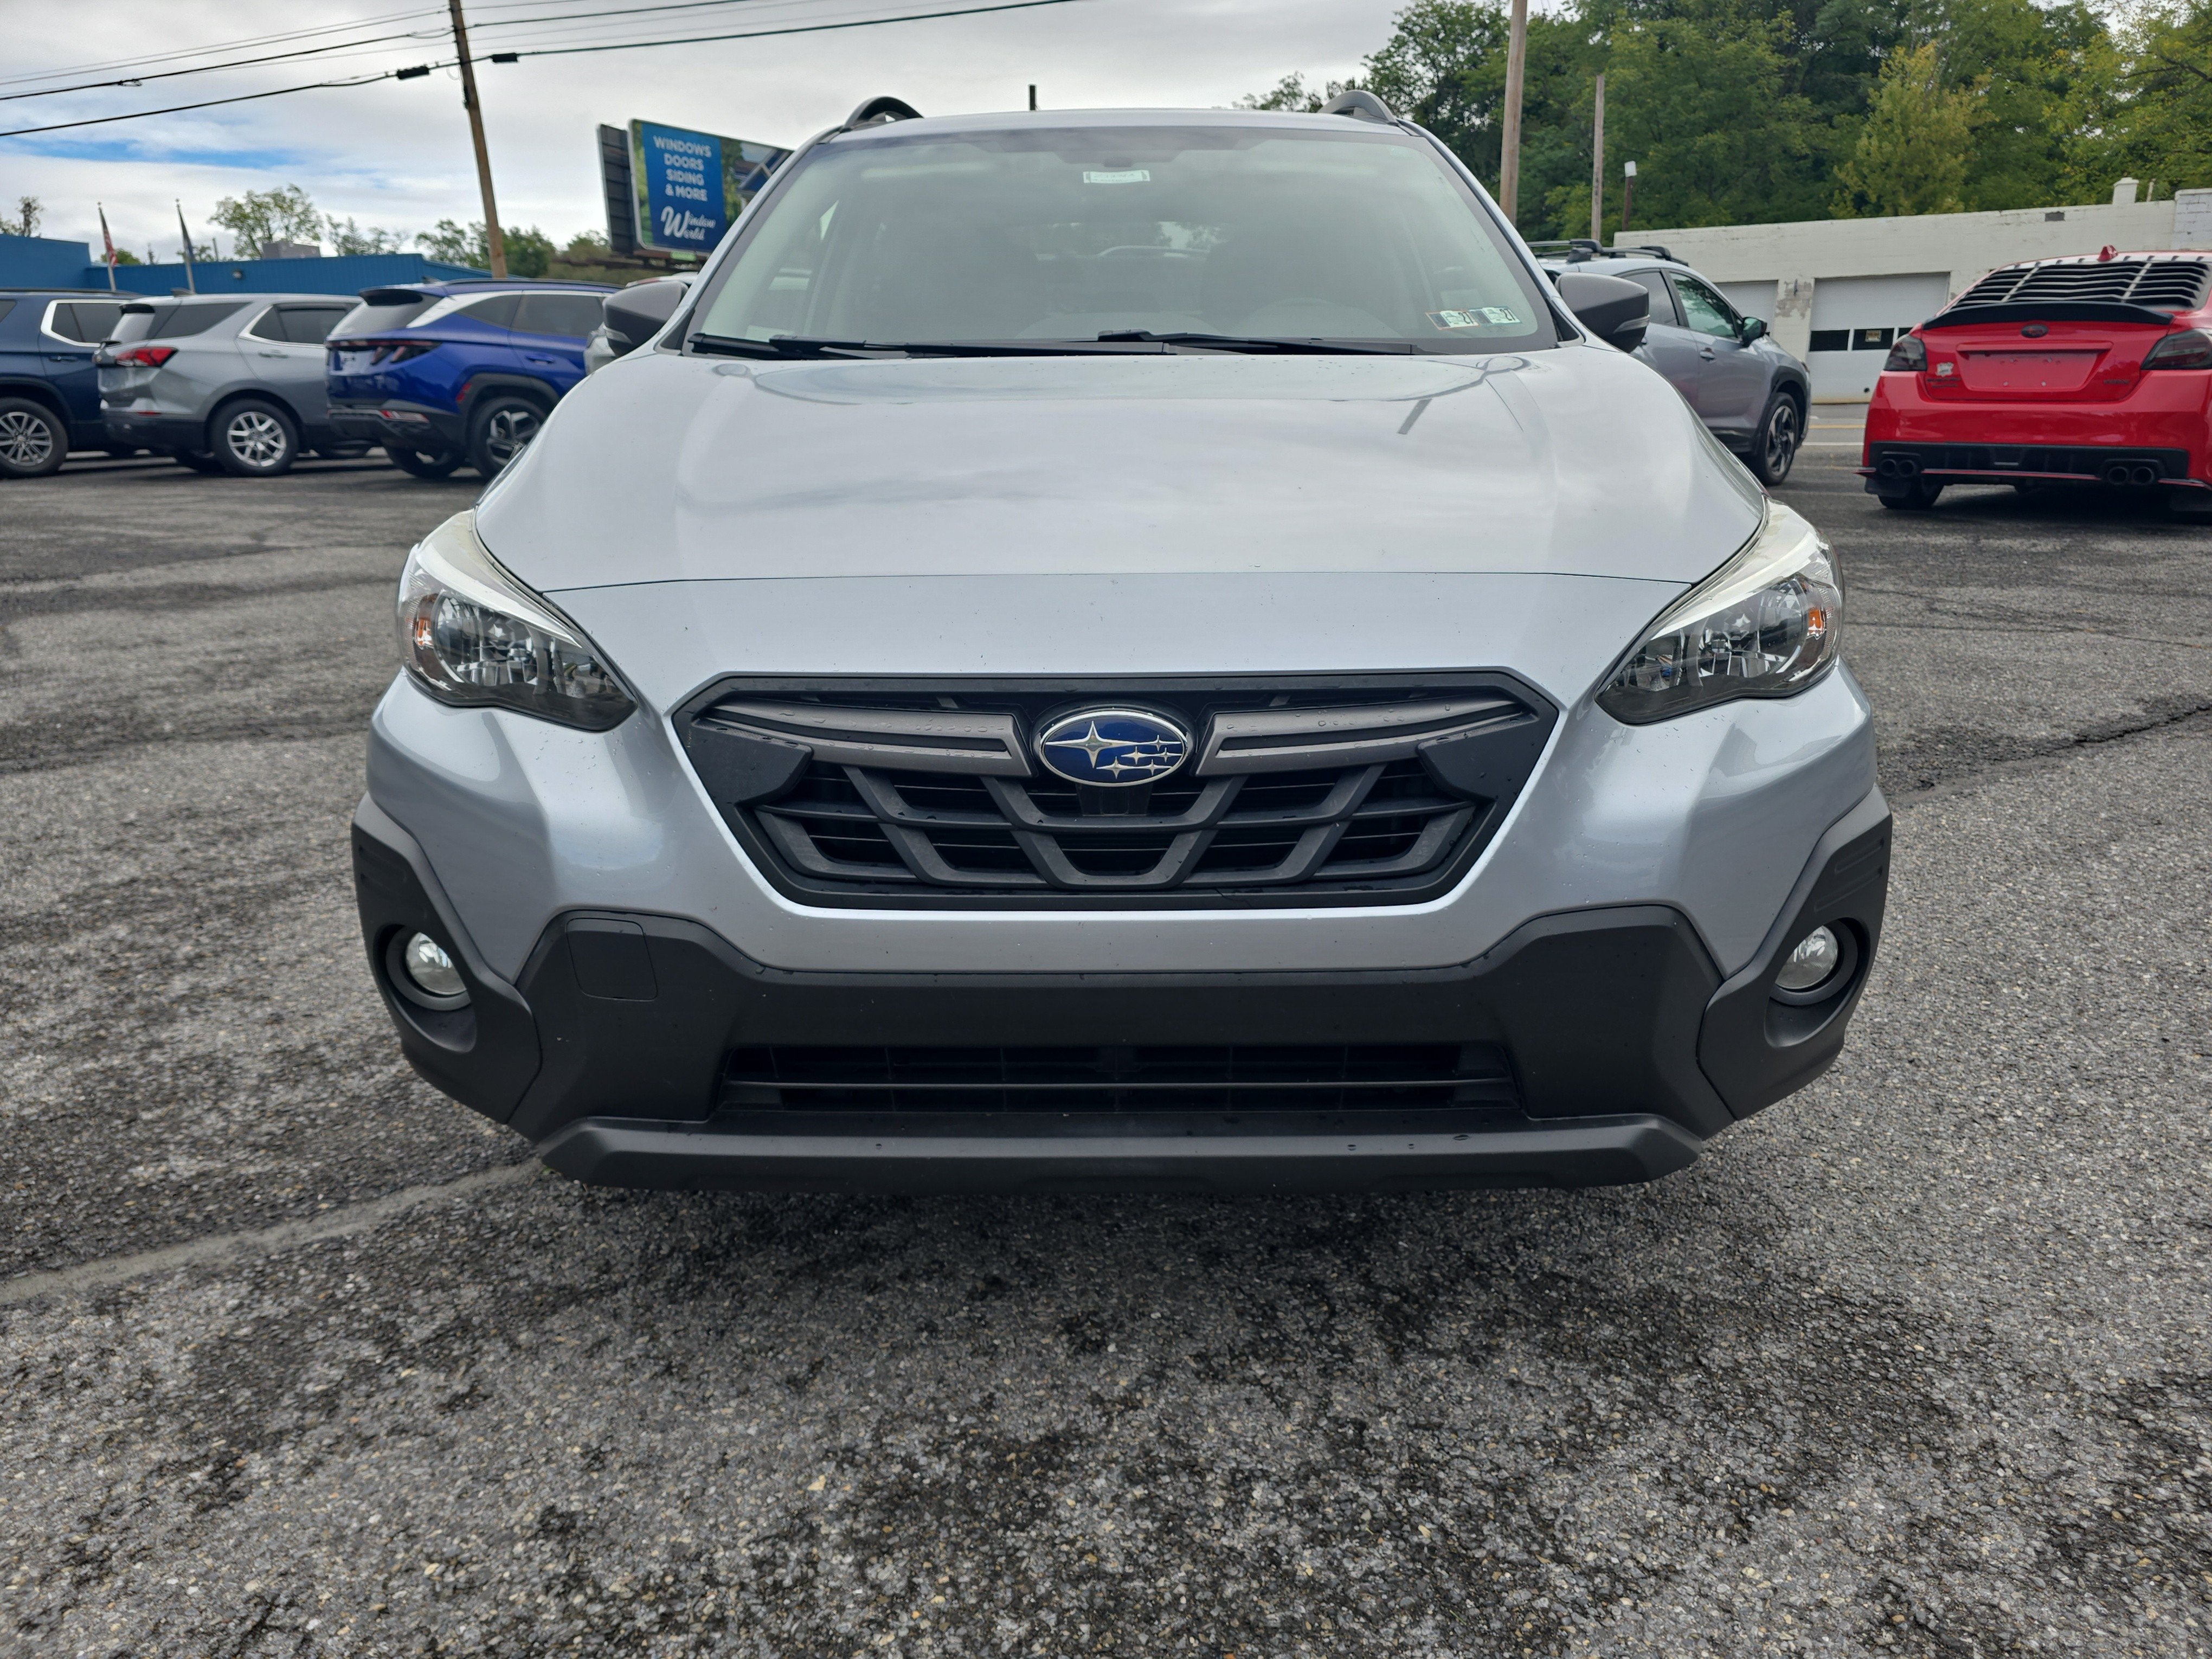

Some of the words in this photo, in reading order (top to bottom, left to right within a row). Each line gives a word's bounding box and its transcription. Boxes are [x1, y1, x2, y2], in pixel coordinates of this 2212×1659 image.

[652, 135, 712, 158] WINDOWS
[664, 152, 704, 171] DOORS
[666, 168, 705, 186] SIDING
[665, 183, 674, 196] &
[675, 185, 708, 202] MORE
[660, 205, 716, 238] Window
